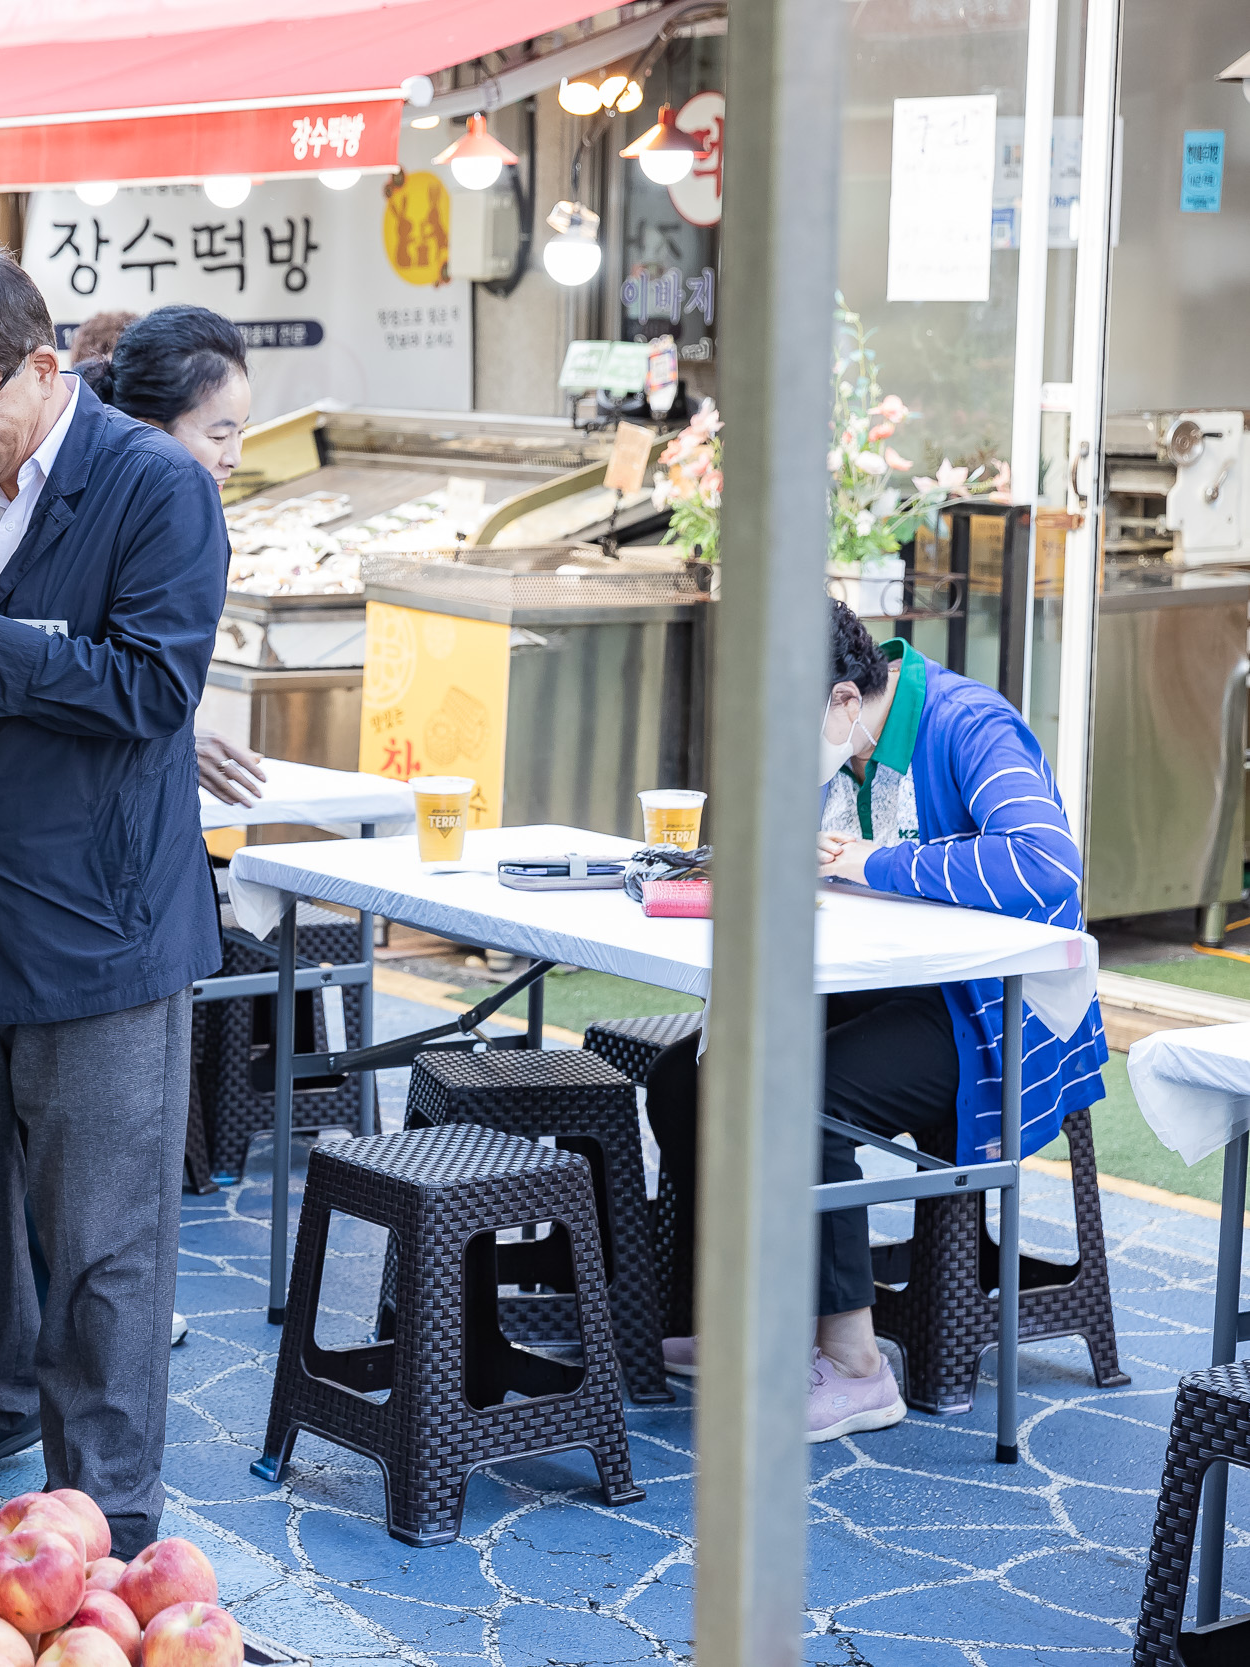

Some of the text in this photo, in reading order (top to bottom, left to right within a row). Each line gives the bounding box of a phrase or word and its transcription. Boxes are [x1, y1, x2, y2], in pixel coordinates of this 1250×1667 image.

[291, 113, 365, 160] 장수떡방
[49, 216, 319, 295] 장수떡방
[427, 815, 462, 828] TERRA
[661, 829, 697, 843] TERRA
[898, 829, 920, 839] K2
